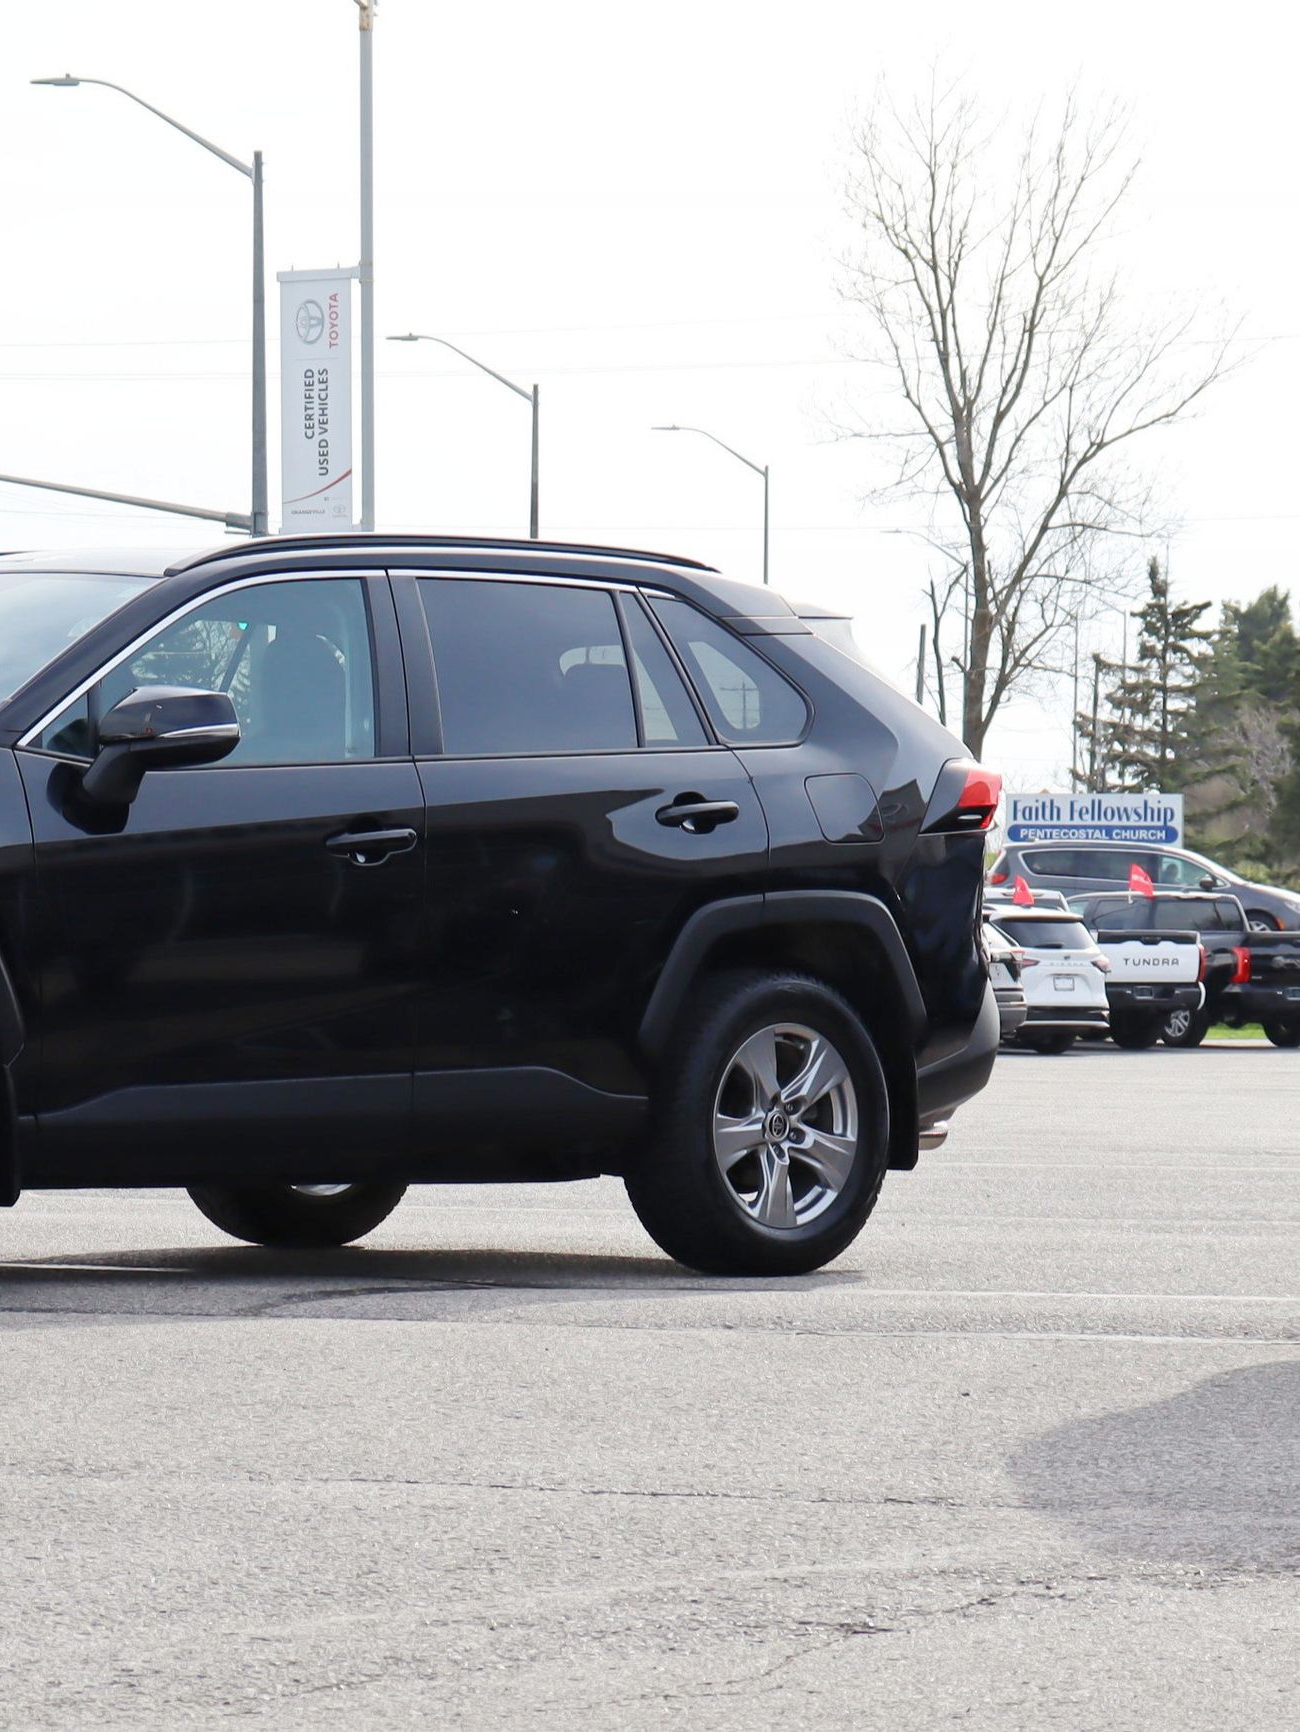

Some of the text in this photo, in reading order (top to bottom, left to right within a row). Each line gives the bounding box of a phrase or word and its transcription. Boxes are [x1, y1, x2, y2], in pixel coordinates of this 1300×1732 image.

[329, 293, 339, 349] TOYOTA
[304, 368, 315, 439] CERTIFIED
[318, 368, 329, 476] USED VEHICLES
[1013, 799, 1175, 826] Faith Fellowship
[1020, 828, 1166, 840] PENTECOSTAL CHURCH
[1124, 958, 1179, 966] TUNDRA
